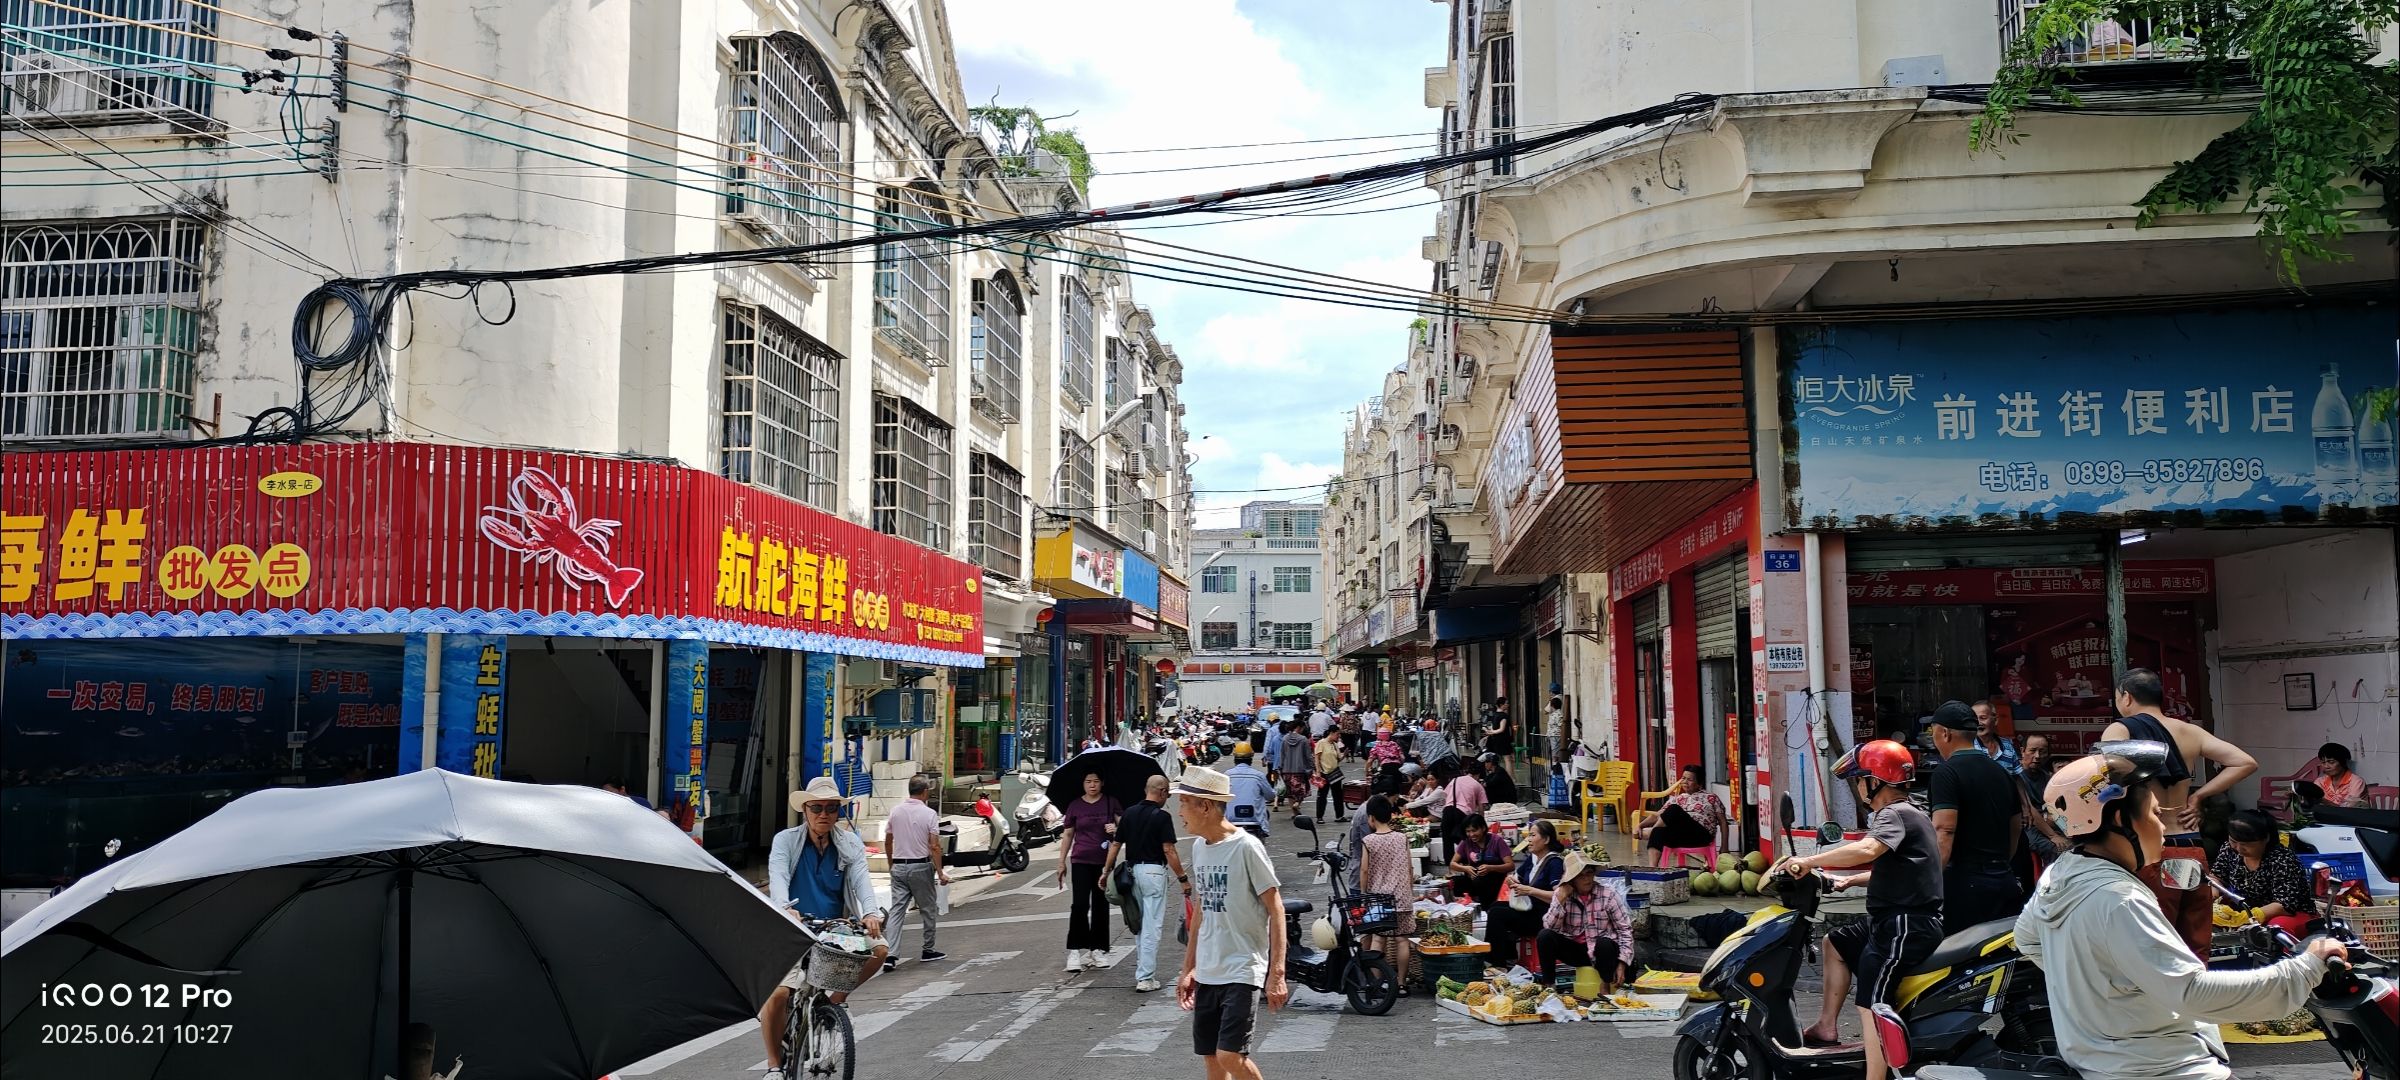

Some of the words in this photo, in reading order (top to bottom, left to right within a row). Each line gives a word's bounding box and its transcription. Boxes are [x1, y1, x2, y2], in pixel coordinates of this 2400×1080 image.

[1796, 374, 1917, 408] 恒大冰泉
[1811, 413, 1871, 432] EVERGRANDE
[1874, 412, 1906, 430] SPRING
[1933, 386, 2295, 442] 前进街便利店
[166, 548, 303, 592] 批发点
[715, 525, 849, 626] 航舵海鲜
[1775, 560, 1790, 569] 36
[822, 669, 834, 777] 小龙虾批
